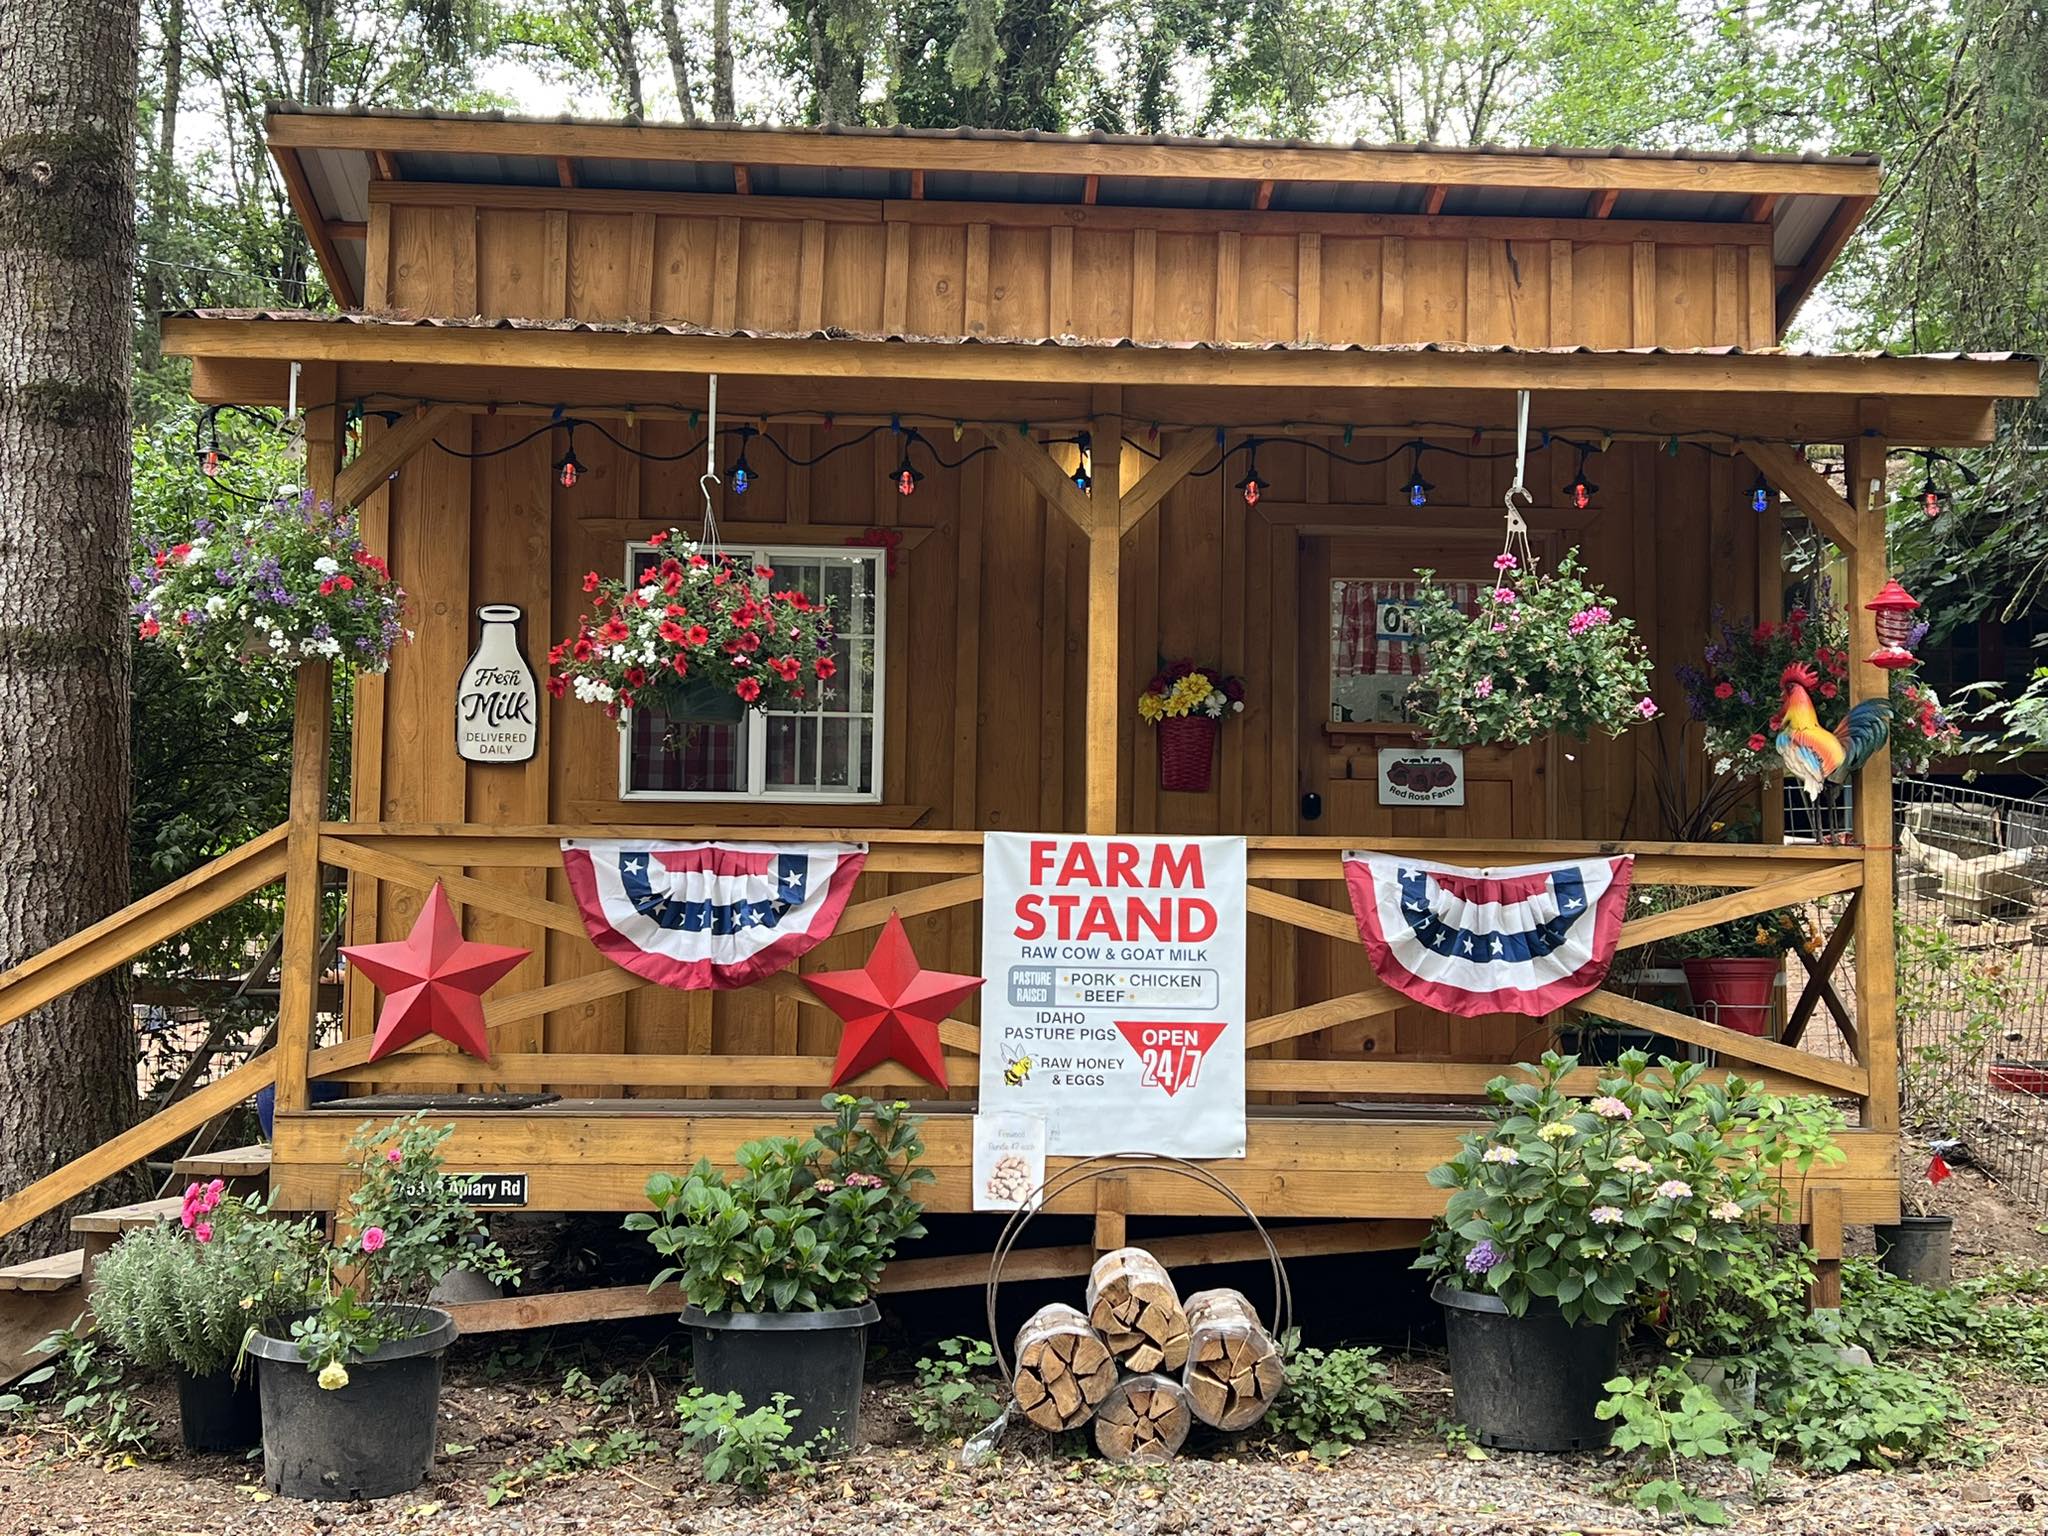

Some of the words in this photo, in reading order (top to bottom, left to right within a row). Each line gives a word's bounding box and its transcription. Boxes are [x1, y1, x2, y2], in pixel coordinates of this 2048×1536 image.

[474, 667, 521, 687] Fresh
[461, 691, 532, 727] Milk
[466, 732, 527, 743] DELIVERED
[479, 744, 513, 754] DAILY
[1389, 785, 1407, 798] Red
[1408, 792, 1431, 801] Rose
[1431, 787, 1455, 799] Farm
[1029, 841, 1205, 889] FARM
[1013, 893, 1218, 943] STAND
[1021, 946, 1057, 959] RAW
[1062, 947, 1103, 960] COW
[1105, 948, 1116, 960] &
[1120, 948, 1165, 961] GOAT
[1169, 949, 1207, 962] MILK
[1012, 970, 1052, 986] PASTURE
[1071, 973, 1116, 986] PORK
[1129, 974, 1202, 987] CHICKEN
[1016, 987, 1048, 1002] RAISED
[1084, 990, 1125, 1002] BEEF
[1036, 1012, 1085, 1024] IDAHO
[1004, 1027, 1075, 1040] PASTURE
[1080, 1028, 1117, 1041] PIGS
[1141, 1029, 1199, 1046] OPEN
[1041, 1057, 1072, 1069] RAW
[1077, 1058, 1125, 1070] HONEY
[1141, 1046, 1202, 1091] 24/7
[1052, 1074, 1061, 1086] &
[1066, 1074, 1104, 1086] EGGS
[448, 1180, 496, 1199] Apiary
[501, 1180, 520, 1196] Rd
